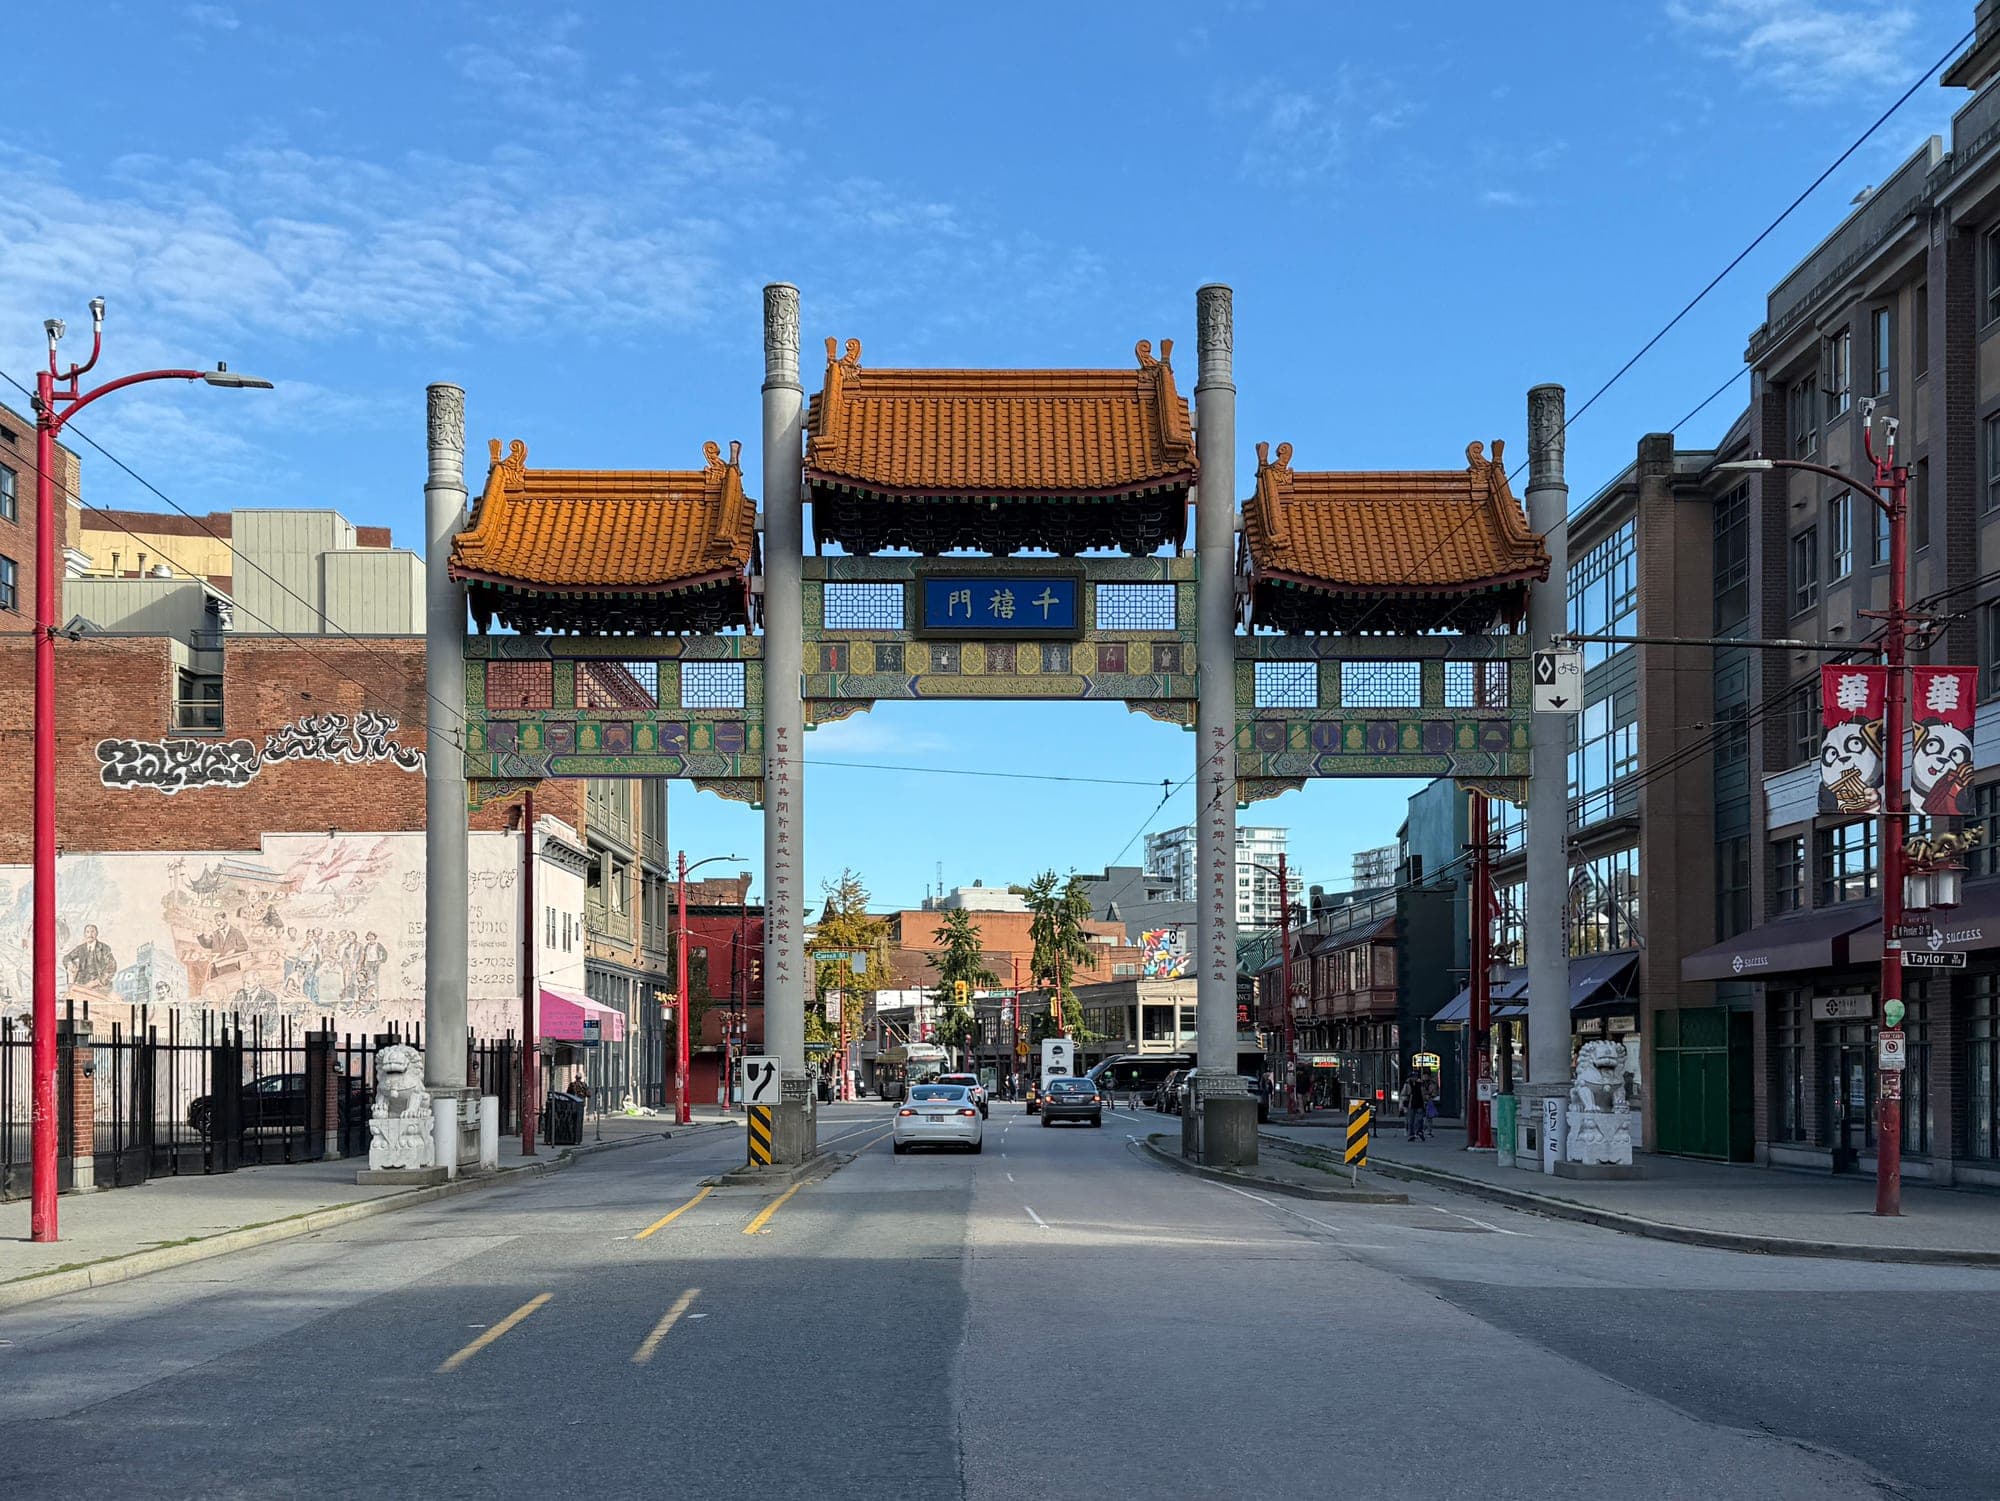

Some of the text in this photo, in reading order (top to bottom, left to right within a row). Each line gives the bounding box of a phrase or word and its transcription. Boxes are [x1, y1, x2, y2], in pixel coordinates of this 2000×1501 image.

[948, 586, 1060, 620] 千禧門
[1911, 953, 1945, 966] Taylor
